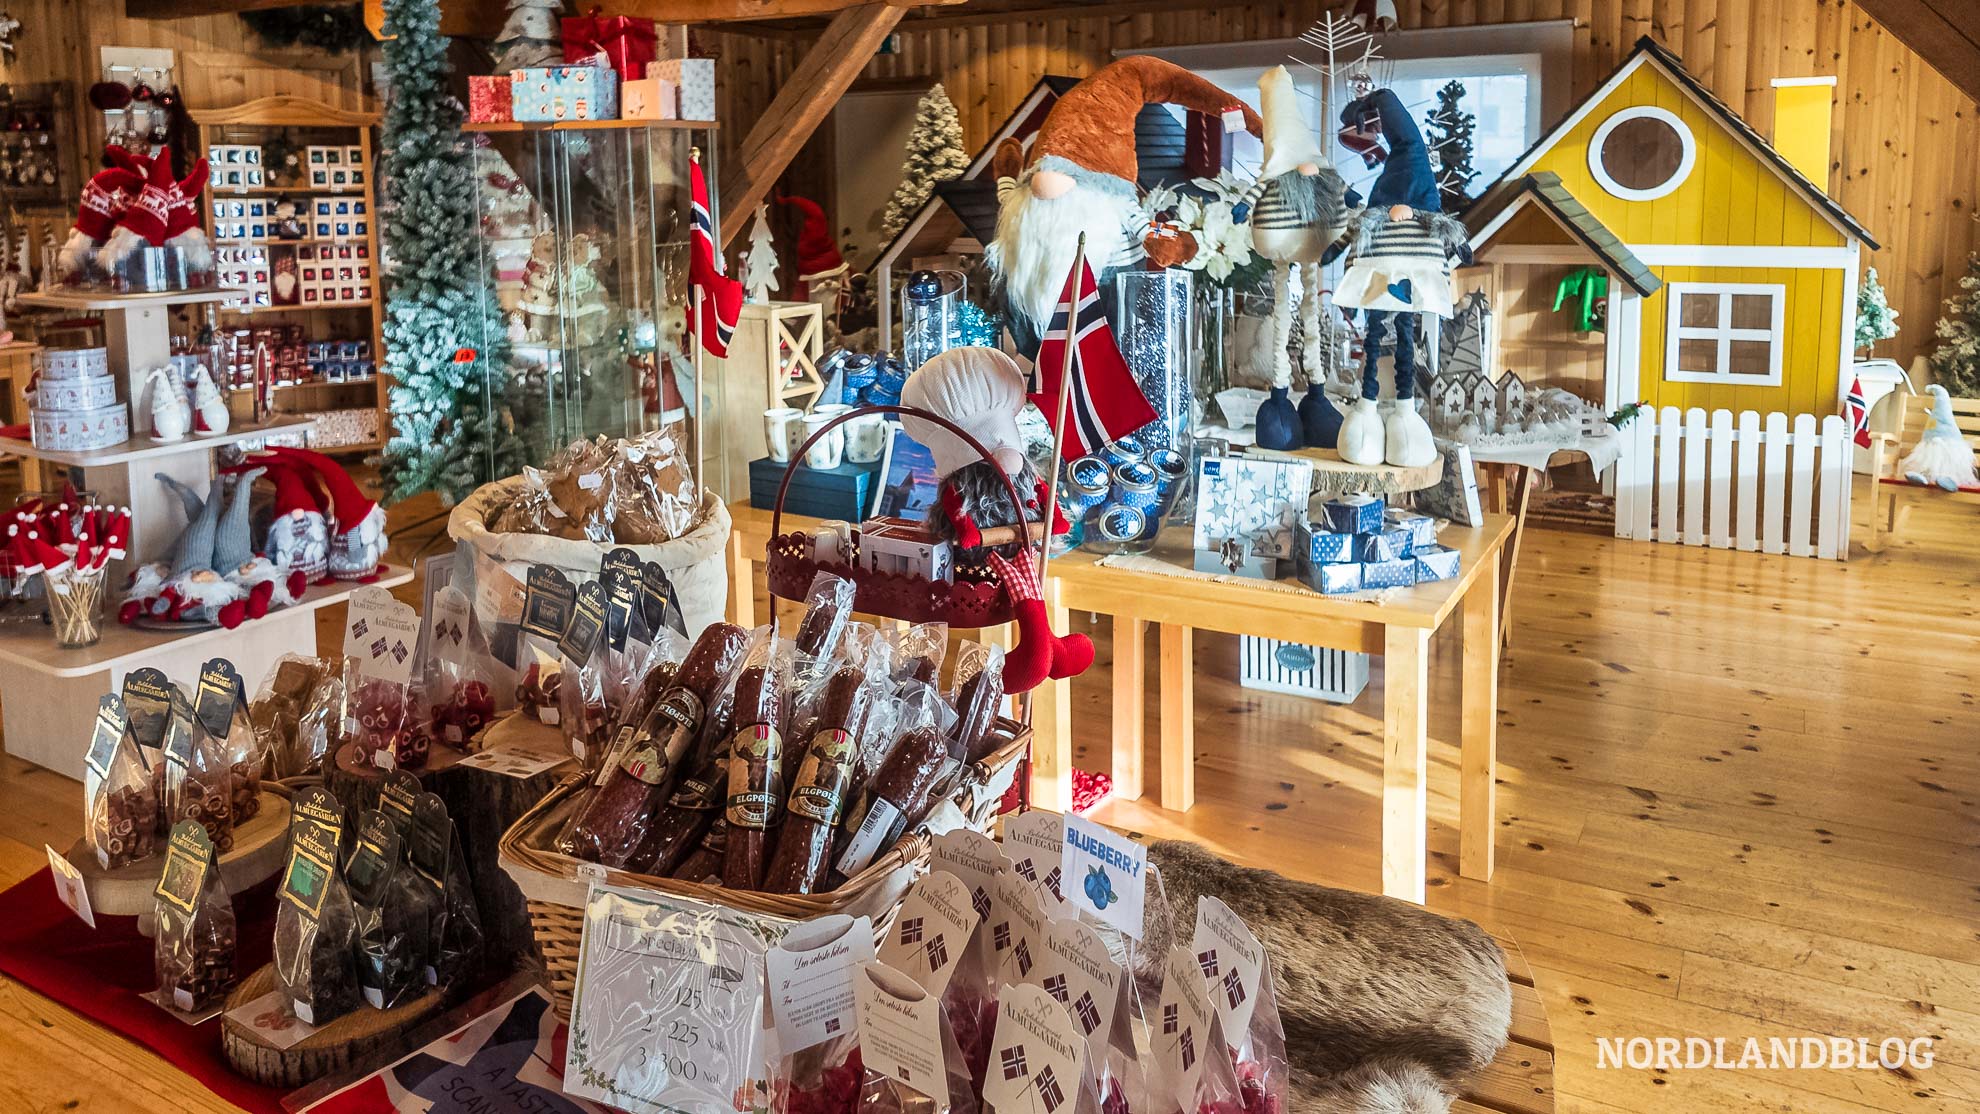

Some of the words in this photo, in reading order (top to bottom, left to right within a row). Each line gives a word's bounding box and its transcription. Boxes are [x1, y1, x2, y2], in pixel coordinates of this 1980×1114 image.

[1009, 828, 1064, 855] ALMUEGAAR
[1066, 827, 1141, 878] BLUEBERRY
[915, 884, 972, 934] ALMUEGAARDEN
[1201, 911, 1258, 967] ALMUEGAARDEN
[1044, 934, 1116, 990] ALMUEGAARDEN
[675, 985, 702, 1010] 125
[641, 1014, 653, 1033] 2
[668, 1020, 699, 1049] 225
[1003, 1001, 1078, 1064] ALMUEGAARDEN
[481, 1067, 507, 1083] A
[636, 1046, 647, 1068] 3
[661, 1052, 698, 1081] 300
